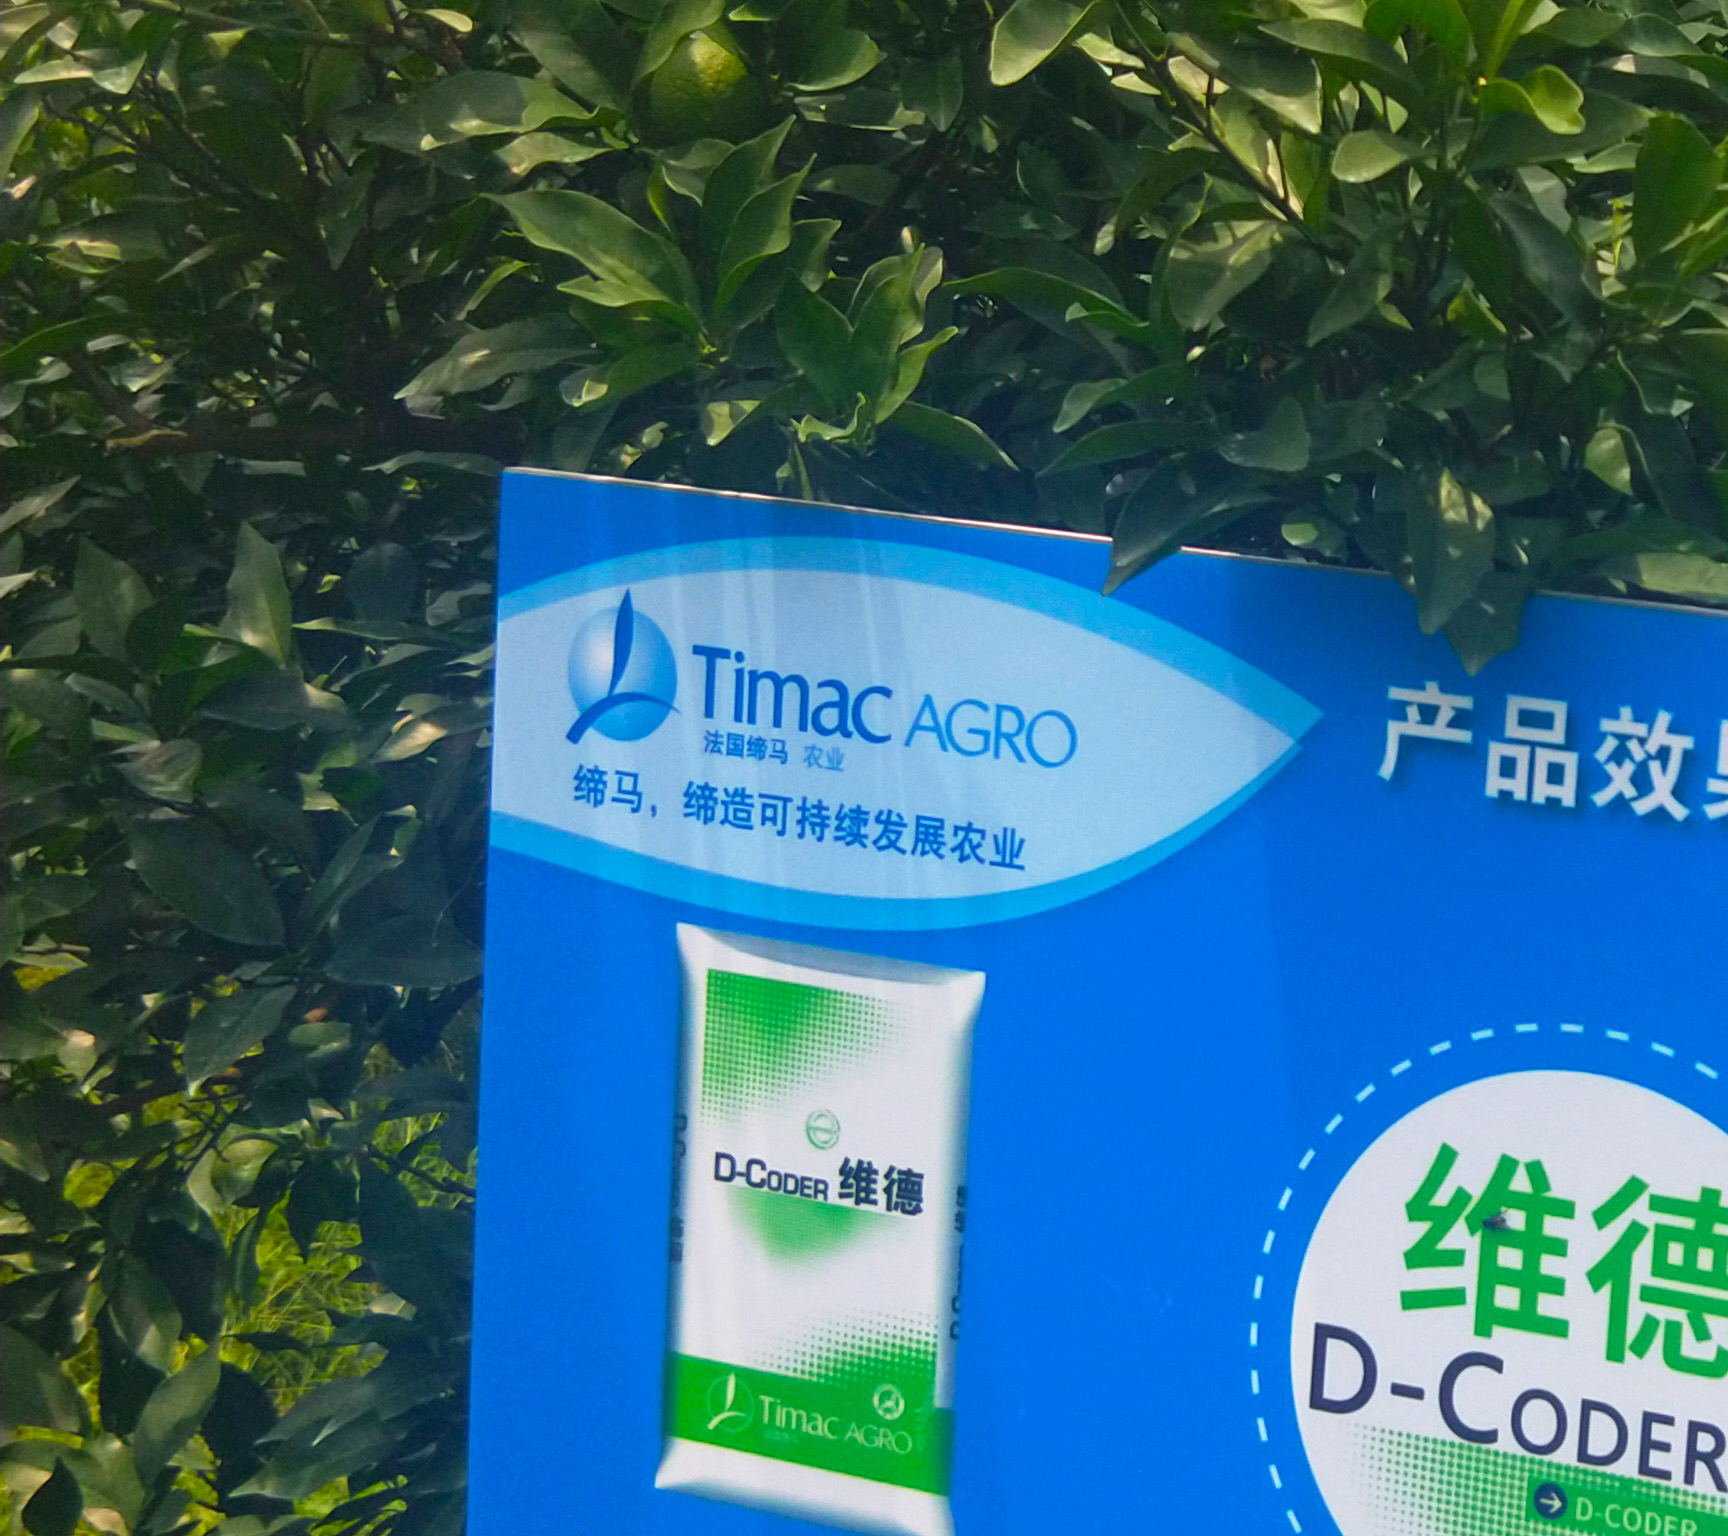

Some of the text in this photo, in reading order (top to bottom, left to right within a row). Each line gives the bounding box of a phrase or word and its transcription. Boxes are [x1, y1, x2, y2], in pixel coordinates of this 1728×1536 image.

[692, 643, 1079, 770] Timac AGRO
[703, 729, 846, 772] 法国缔马 农业
[713, 1151, 925, 1217] D-CODER 维德
[758, 1394, 913, 1455] Timac AGRO
